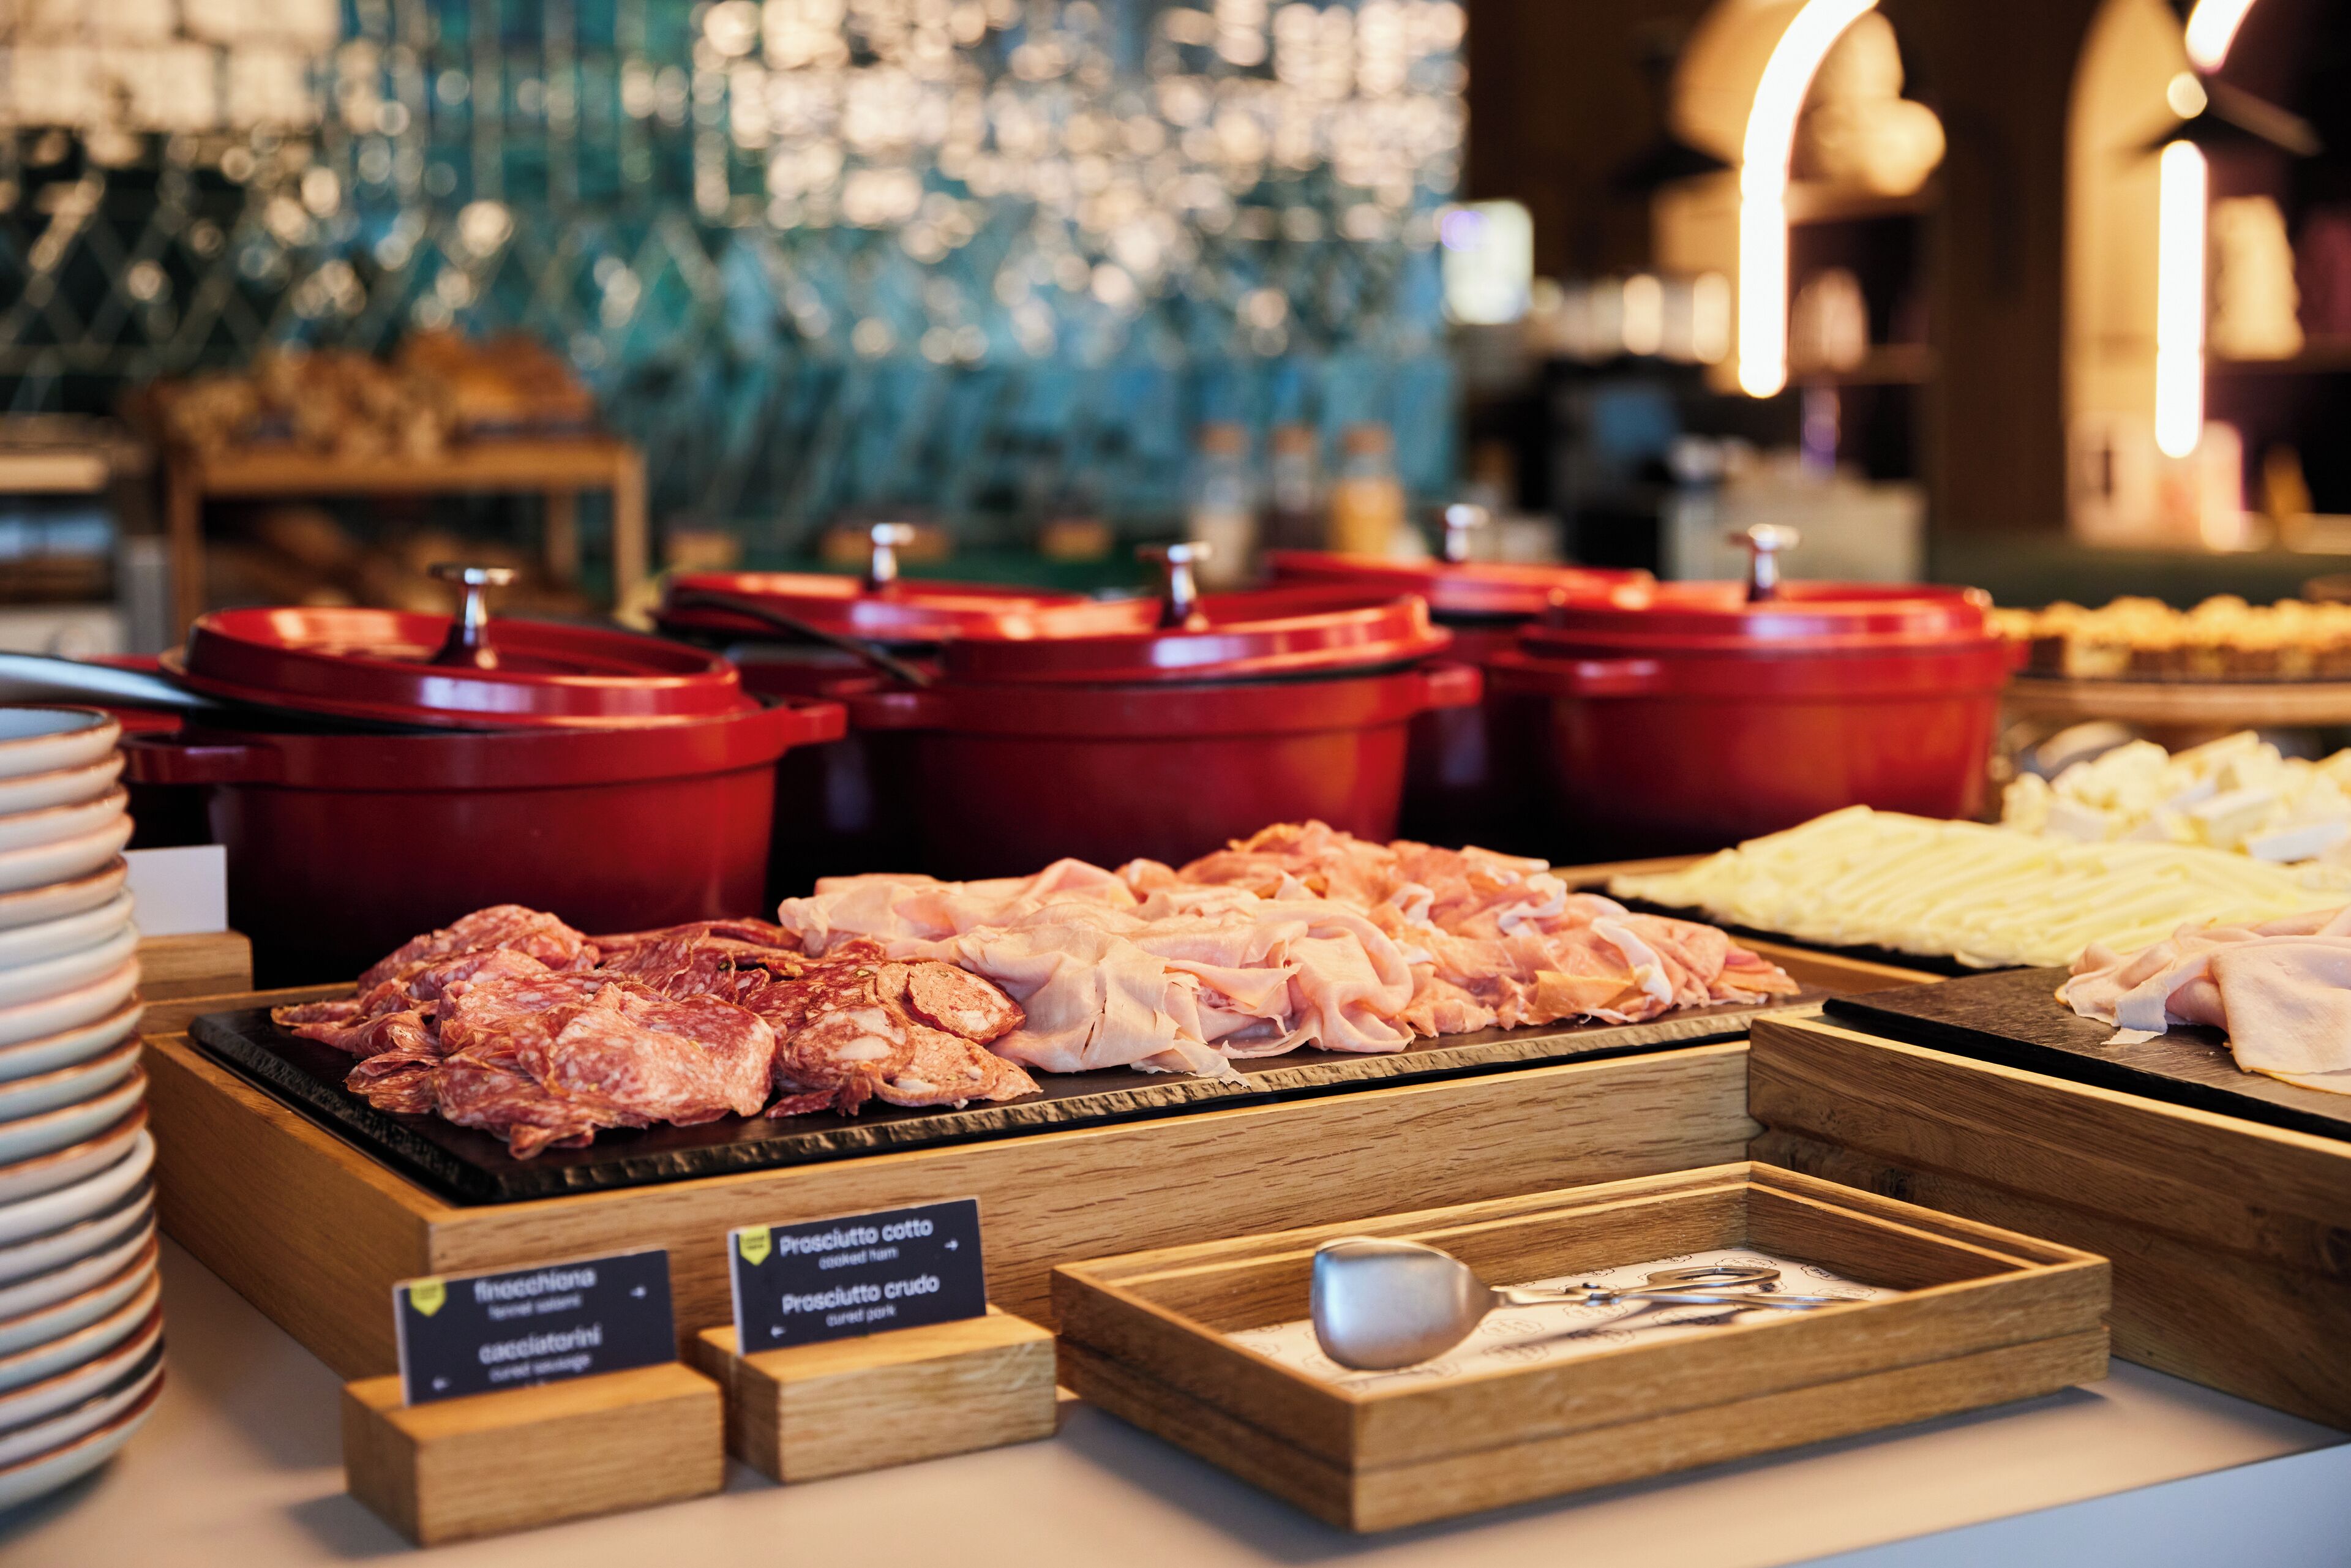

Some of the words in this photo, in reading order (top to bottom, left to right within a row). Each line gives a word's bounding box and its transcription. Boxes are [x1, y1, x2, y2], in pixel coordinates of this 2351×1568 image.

[779, 1226, 879, 1256] Prosciutto
[881, 1218, 934, 1242] cotto
[869, 1247, 899, 1262] ham
[782, 1286, 881, 1315] Prosciutto
[883, 1274, 940, 1299] crudo
[479, 1322, 602, 1365] cacciatorini
